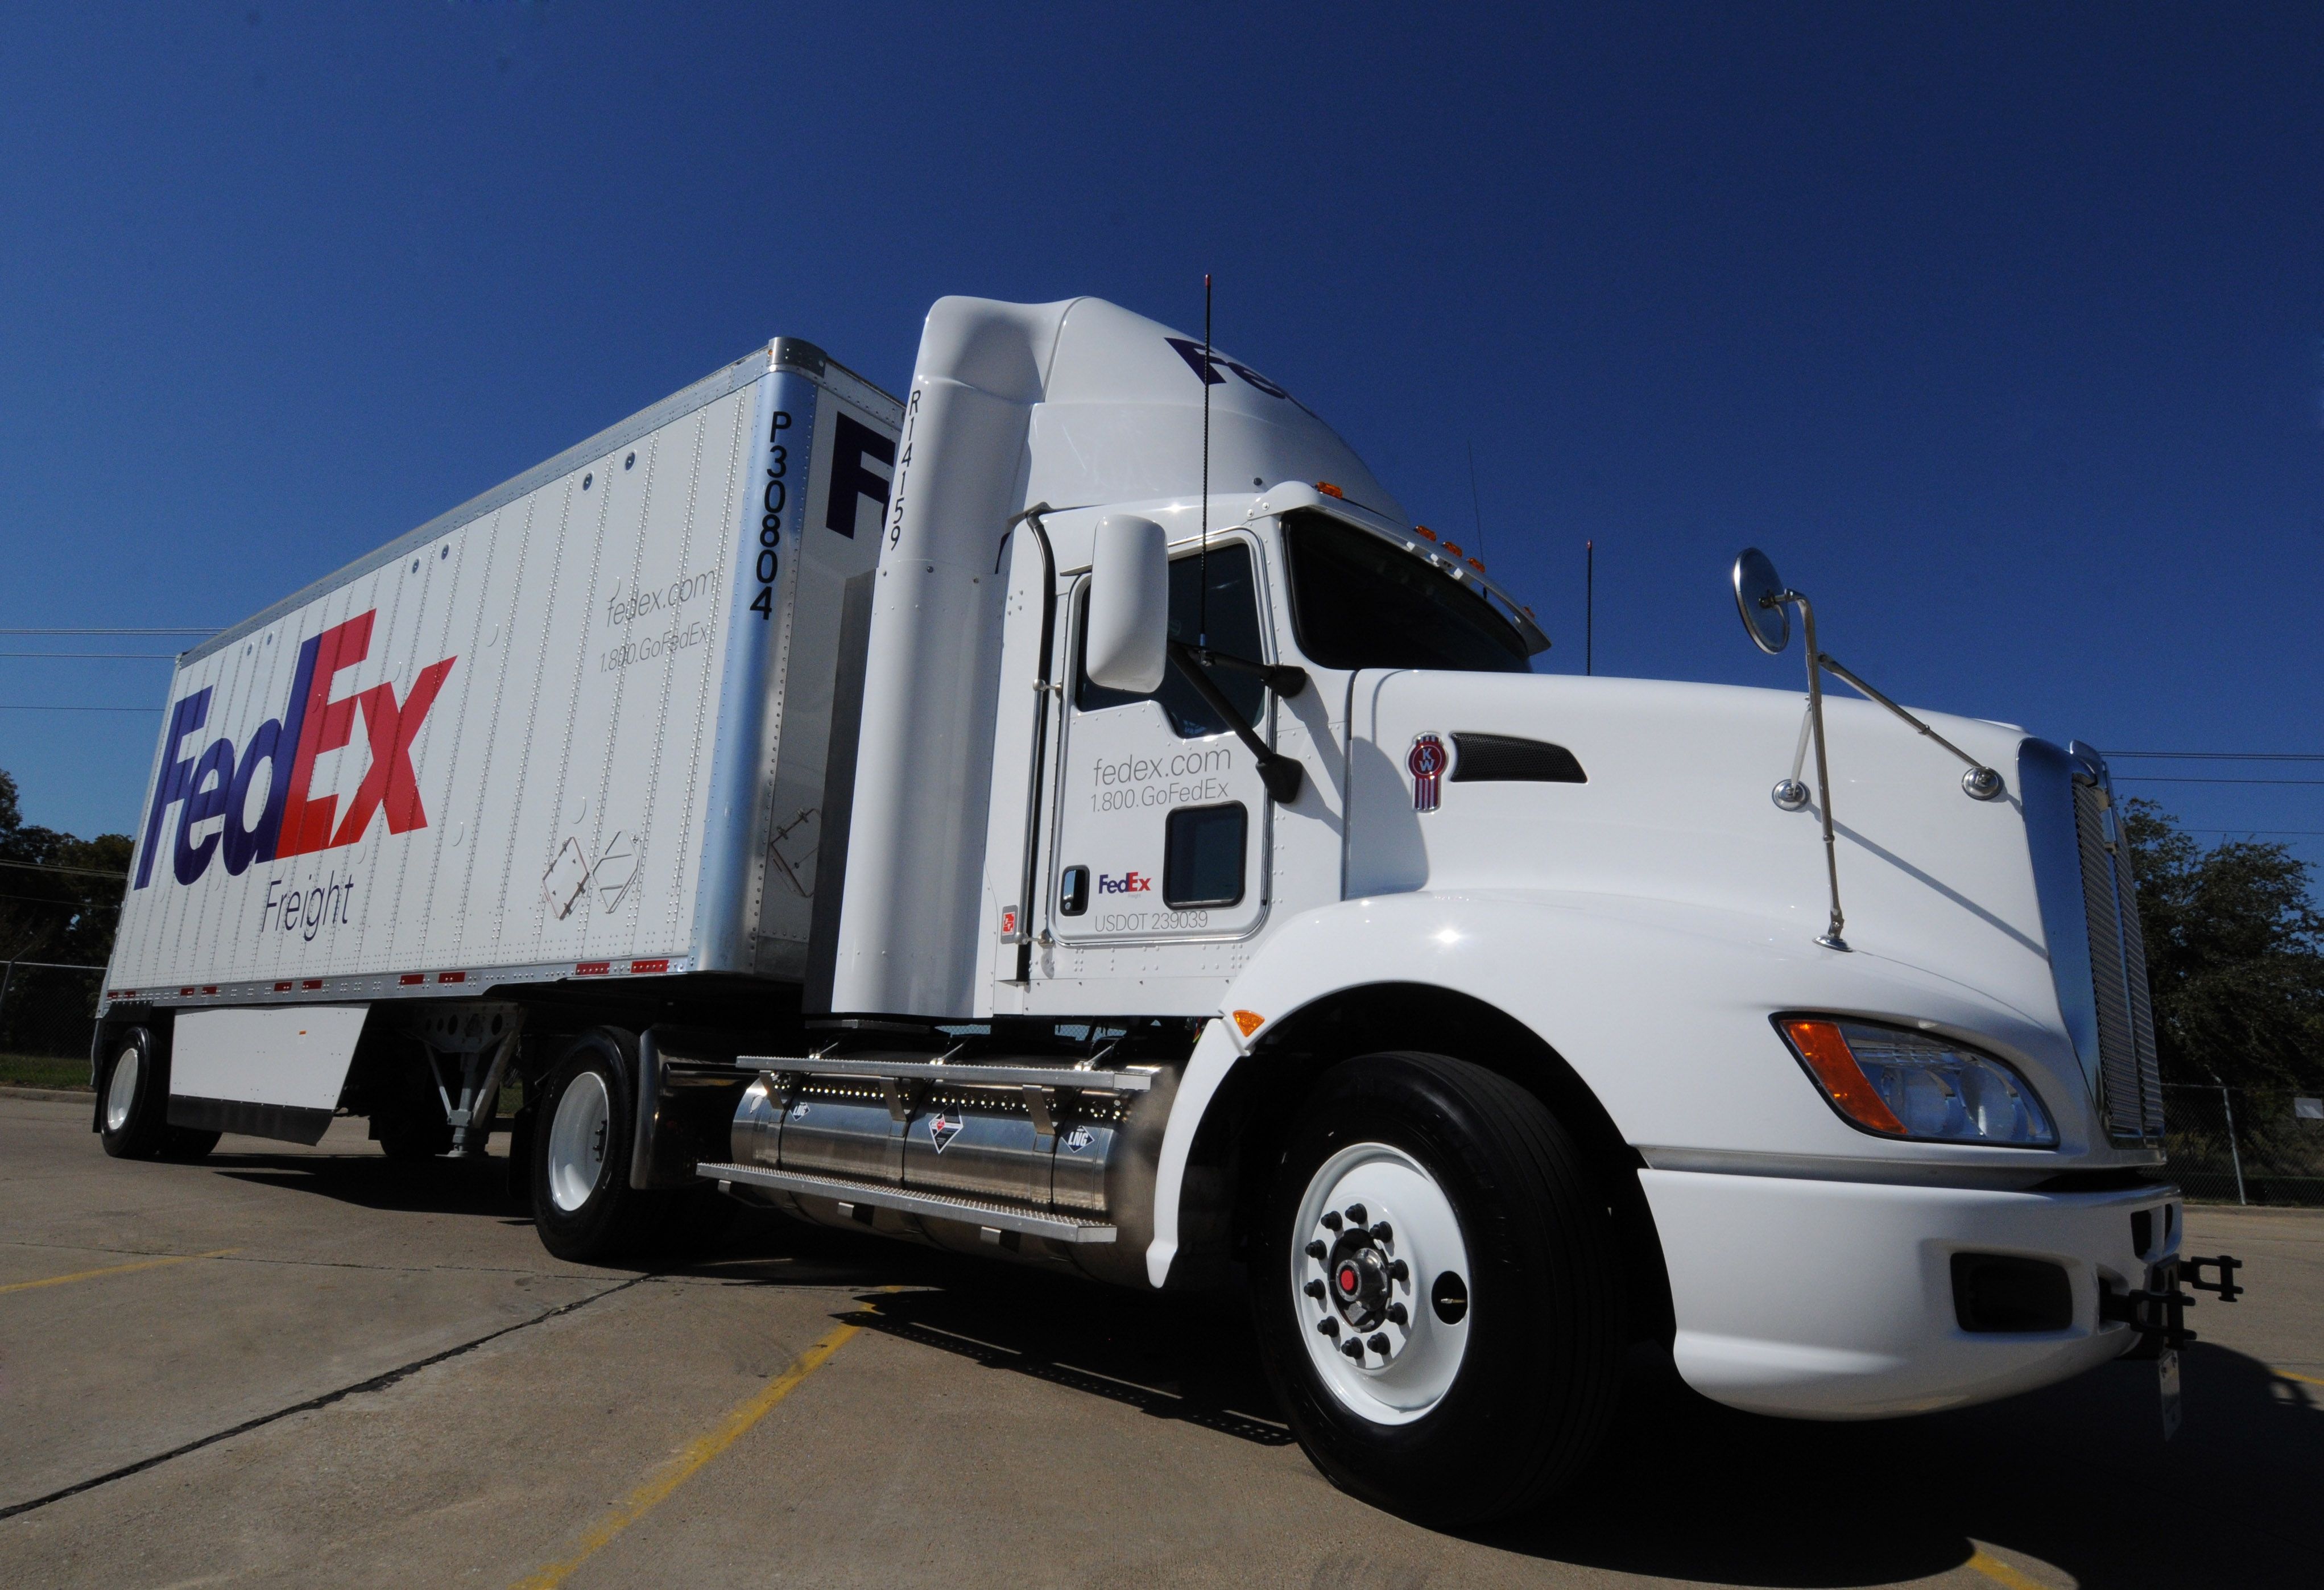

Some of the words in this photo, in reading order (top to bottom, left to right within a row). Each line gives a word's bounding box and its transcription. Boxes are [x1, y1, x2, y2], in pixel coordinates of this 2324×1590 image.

[890, 389, 921, 551] R14159
[749, 410, 792, 621] P30804
[606, 570, 715, 628] fedex.com
[600, 621, 709, 673] 1.800.GoFedEx
[133, 608, 458, 891] FedEx
[1093, 749, 1231, 787] fedex.com
[1090, 778, 1229, 812] 1.800.GoFedEx
[1098, 871, 1152, 894] FedEx
[261, 870, 354, 942] Freight
[1094, 912, 1148, 932] USDOT
[1151, 910, 1208, 930] 239039
[793, 1105, 807, 1116] LNG
[1068, 1131, 1089, 1147] LNG
